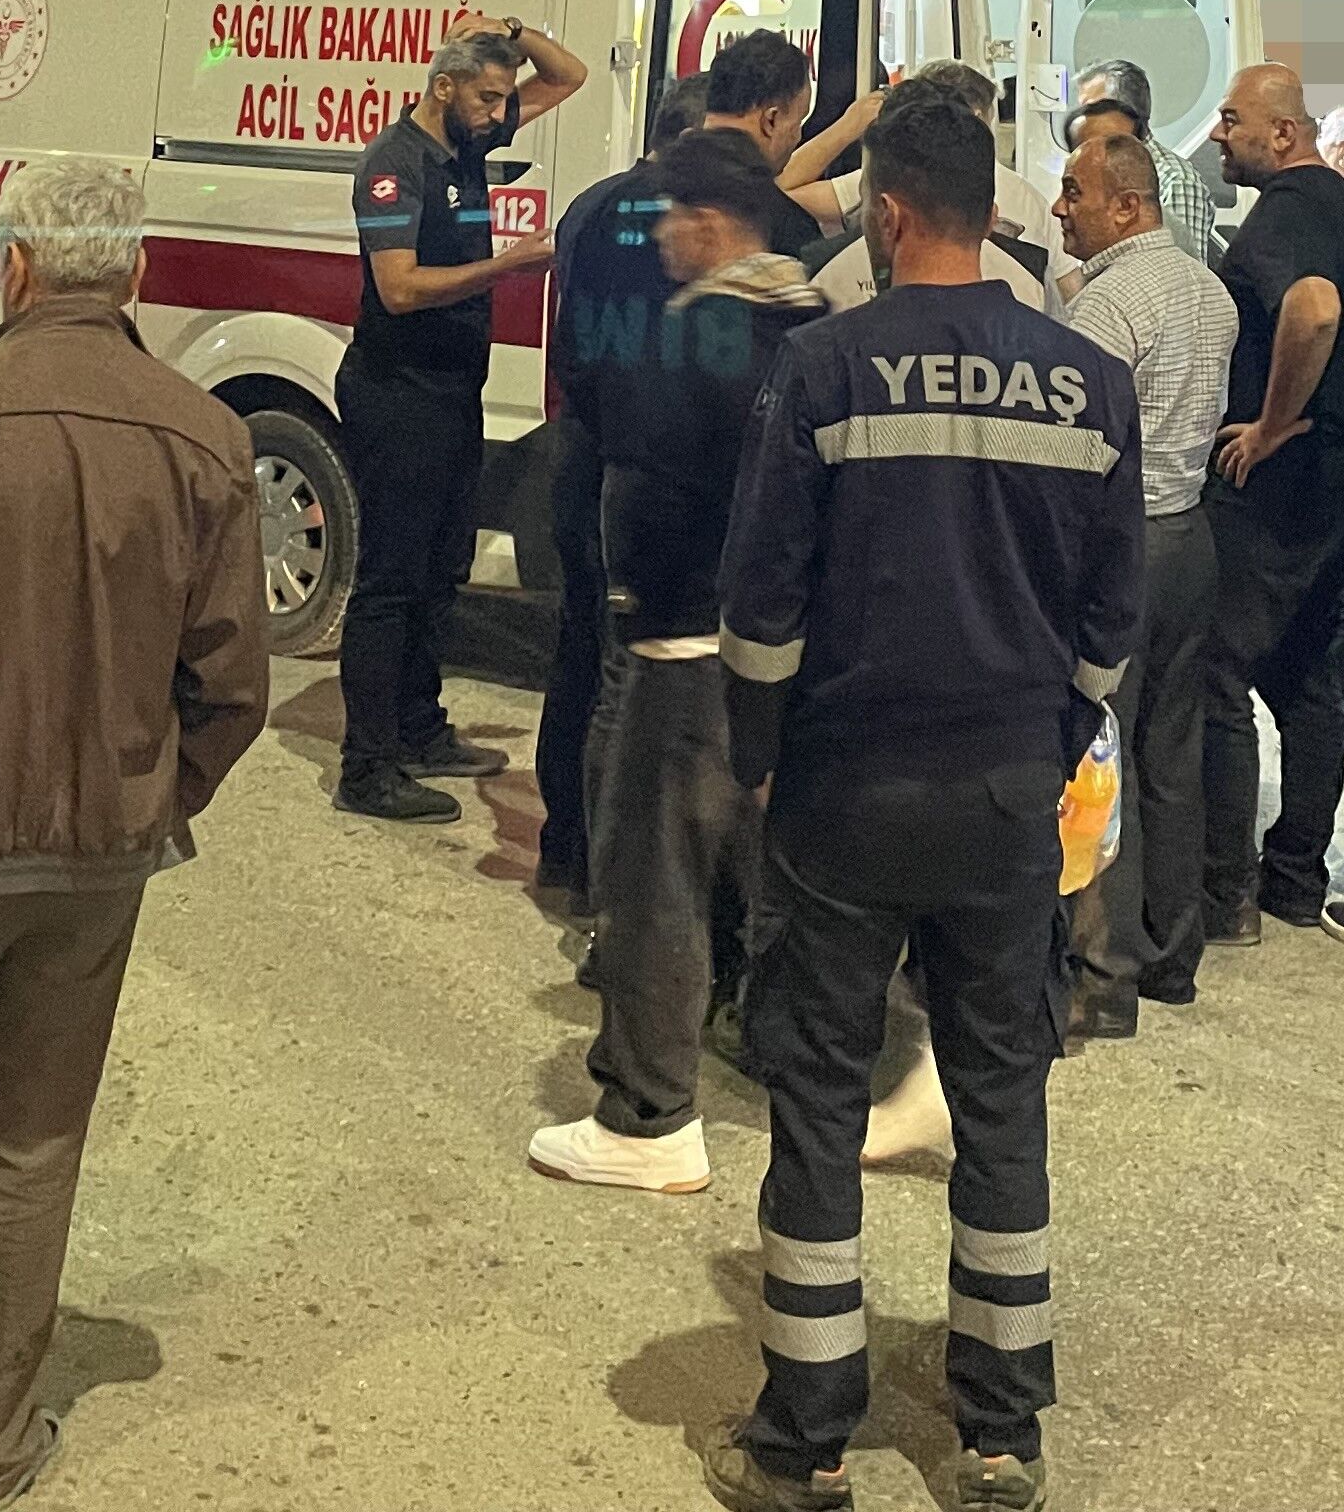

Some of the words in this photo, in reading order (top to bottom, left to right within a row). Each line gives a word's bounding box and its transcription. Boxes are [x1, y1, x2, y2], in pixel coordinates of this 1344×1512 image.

[236, 75, 305, 140] ACİL
[495, 195, 537, 233] 112
[871, 354, 1087, 426] YEDAŞ
